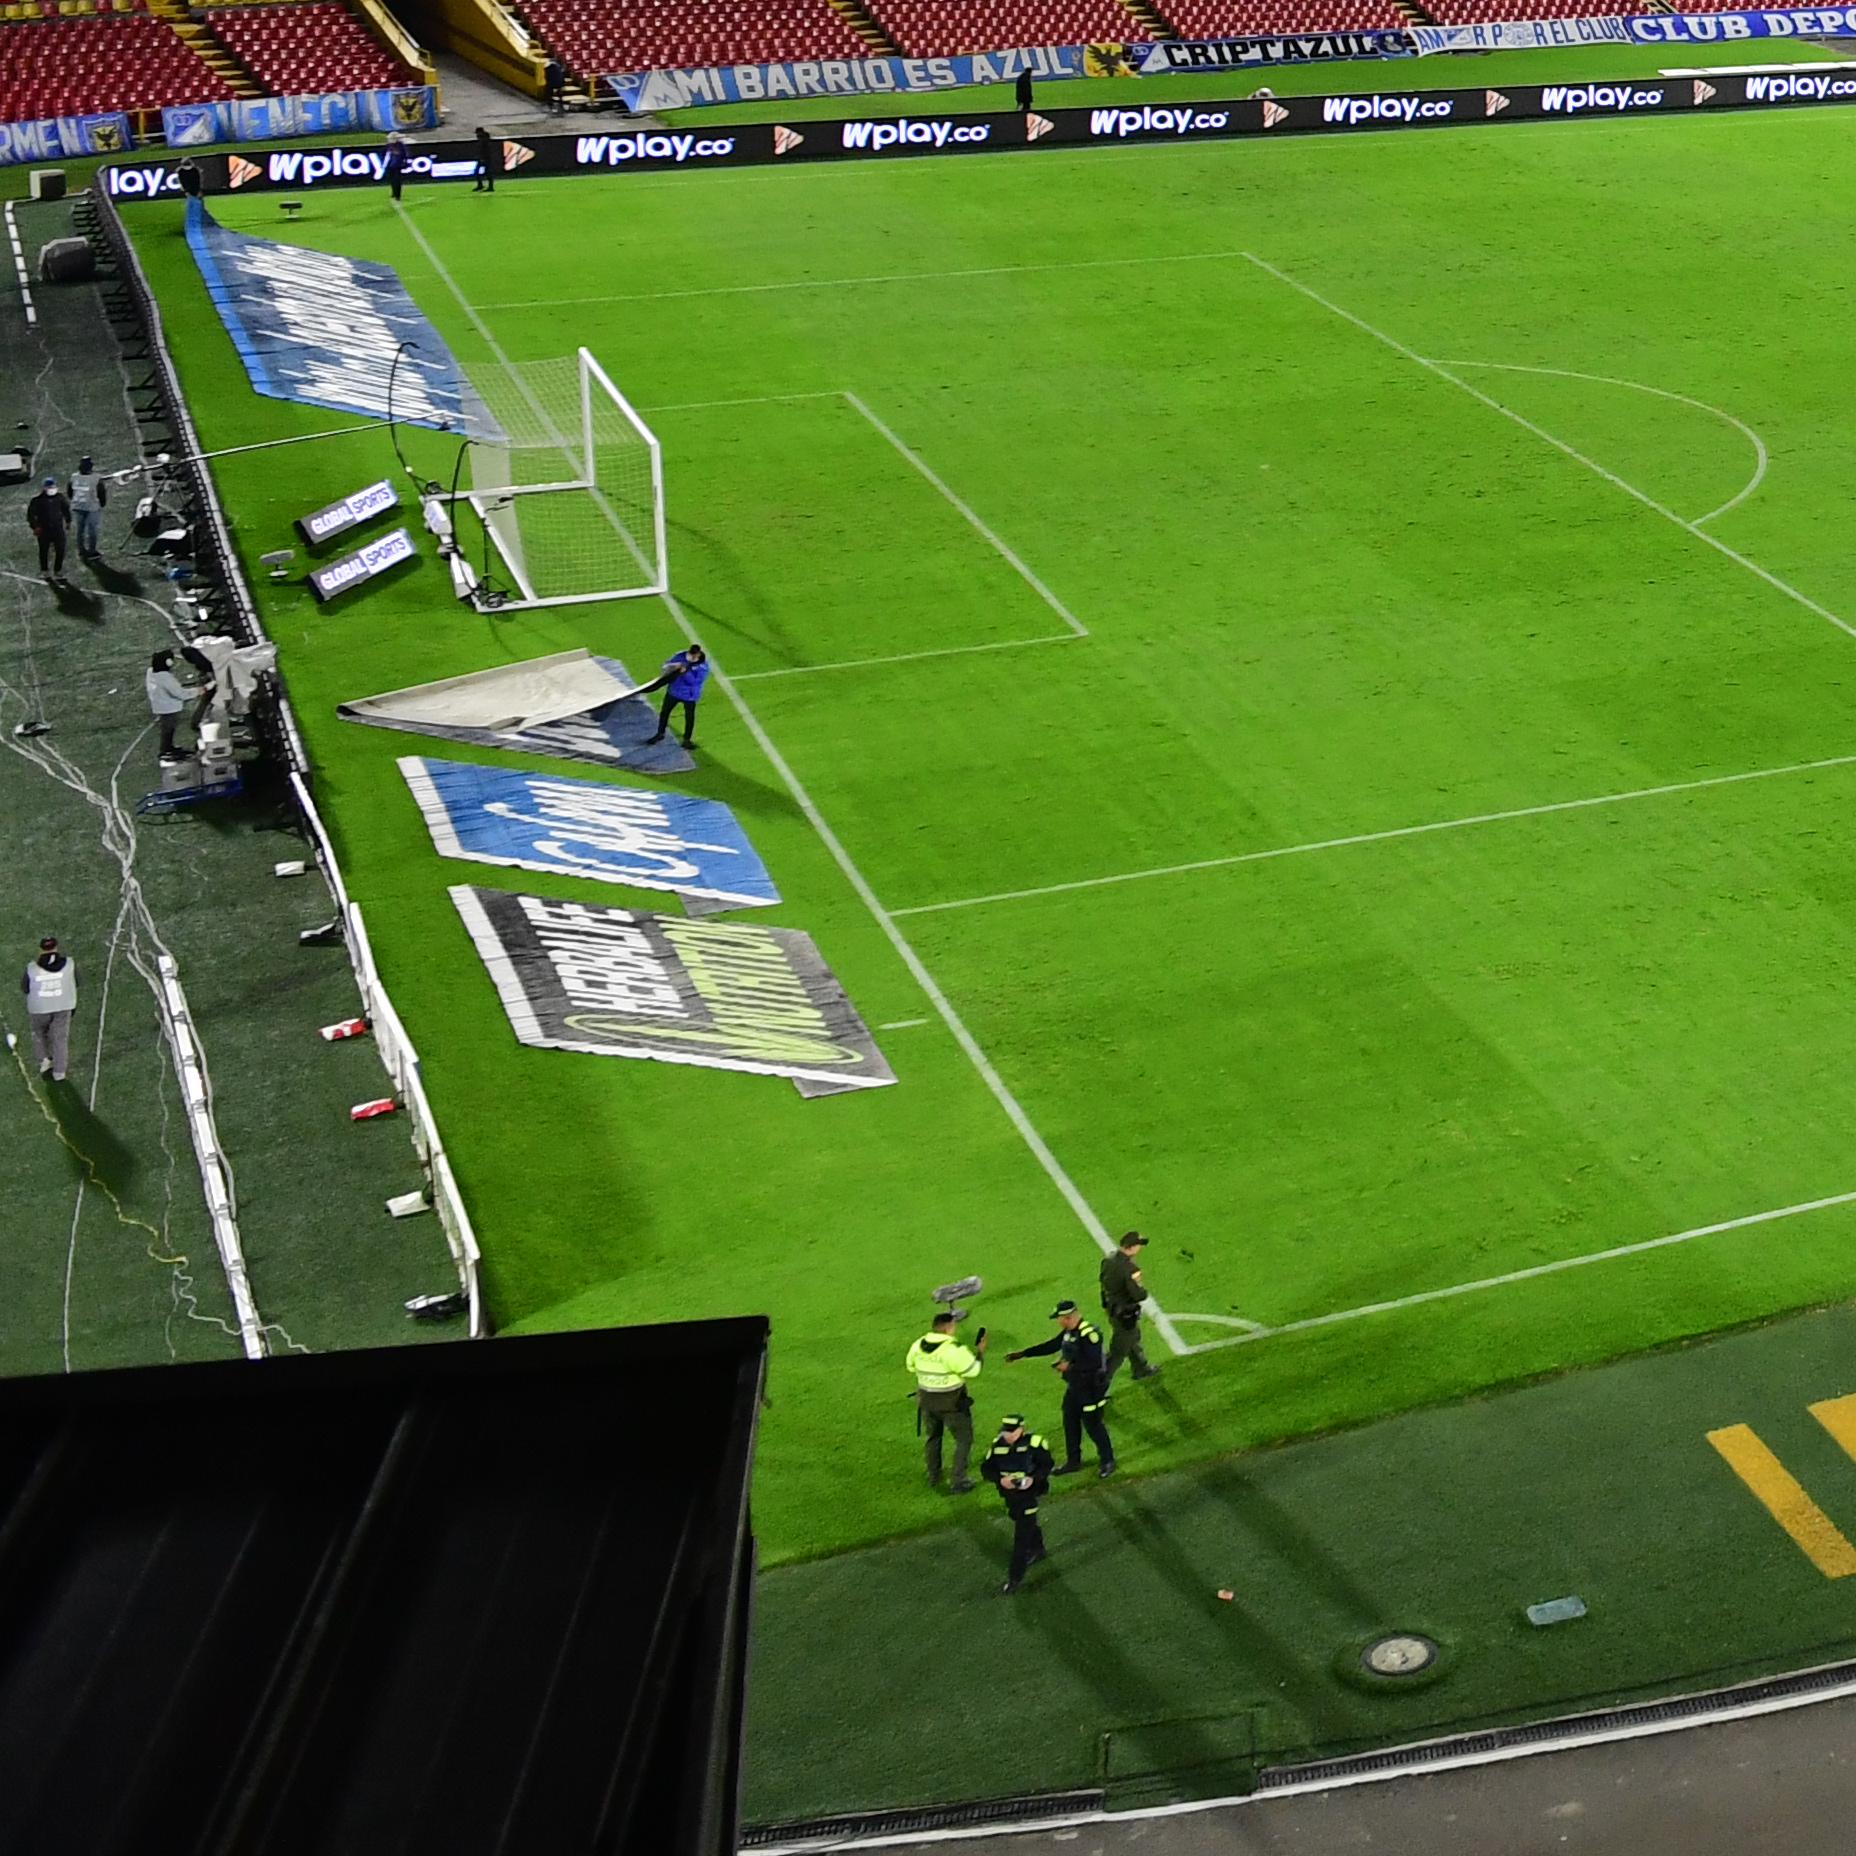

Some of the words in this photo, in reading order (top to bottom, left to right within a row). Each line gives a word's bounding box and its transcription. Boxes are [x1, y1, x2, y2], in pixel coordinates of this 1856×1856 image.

[1553, 19, 1576, 45] EL
[1579, 14, 1625, 43] CLUB
[1631, 14, 1752, 43] CLUB
[1164, 31, 1378, 68] CRIPTAZUL
[682, 68, 728, 104] MI
[735, 58, 897, 101] BARRIO
[903, 57, 955, 89] ES
[970, 45, 1073, 83] AZUL
[216, 90, 383, 142] VENECIA
[1323, 95, 1454, 127] Wplay.co
[1541, 84, 1663, 115] Wplay.co
[841, 118, 990, 152] Wplay.co
[1089, 106, 1228, 138] Wplay.co
[576, 132, 733, 167] Wplay.co
[310, 503, 354, 536] GLOBAL
[352, 486, 391, 515] SPORTS
[319, 558, 367, 590] GLOBAL
[365, 536, 407, 568] SPORTS
[517, 895, 690, 1019] HERBALIFE
